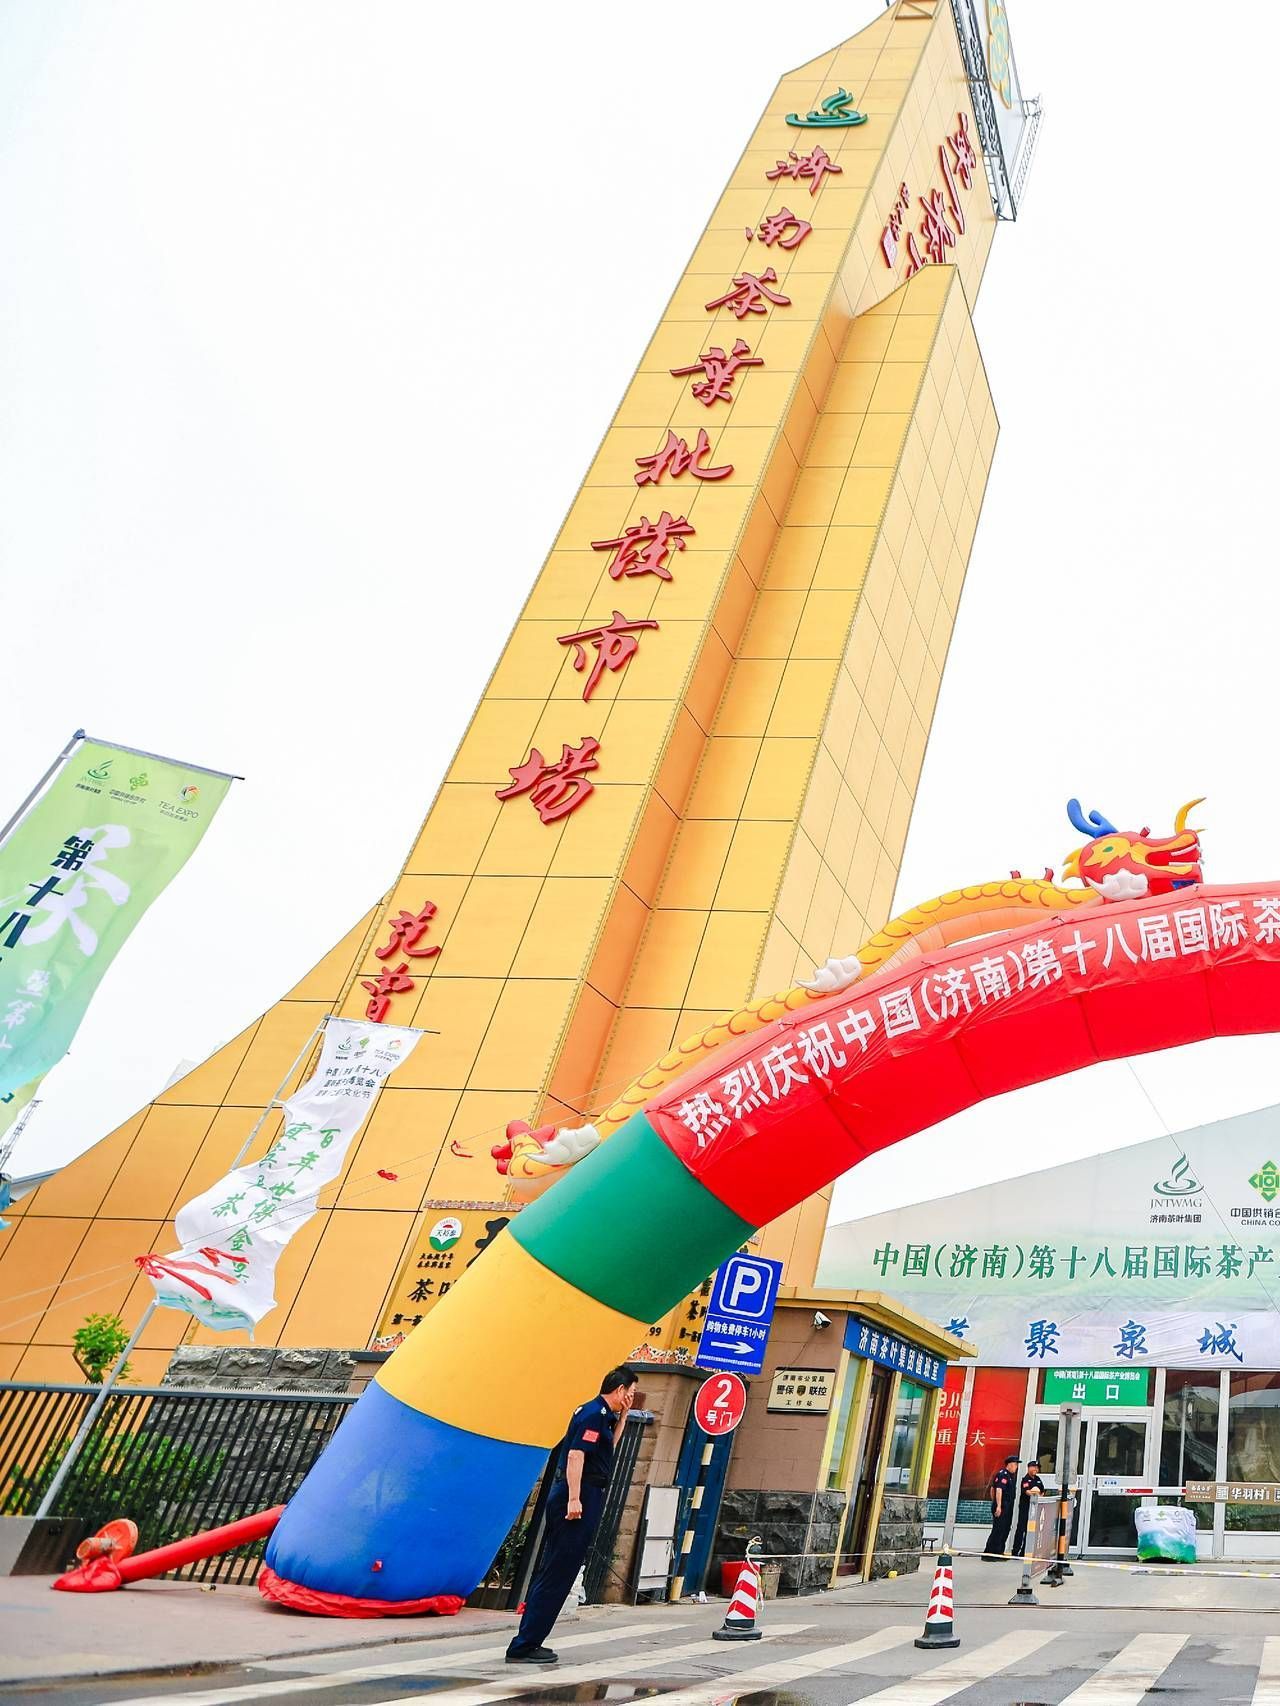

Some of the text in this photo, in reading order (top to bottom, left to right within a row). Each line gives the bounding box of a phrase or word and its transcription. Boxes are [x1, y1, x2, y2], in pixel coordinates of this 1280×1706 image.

[1150, 1198, 1203, 1209] JNTWMG
[1149, 1213, 1202, 1224] 济南茶叶集团
[728, 1265, 762, 1308] P
[706, 1320, 767, 1341] 购物免费停车1小时
[712, 1378, 733, 1408] 2
[1072, 1382, 1120, 1401] 出口
[705, 1410, 734, 1429] 号门
